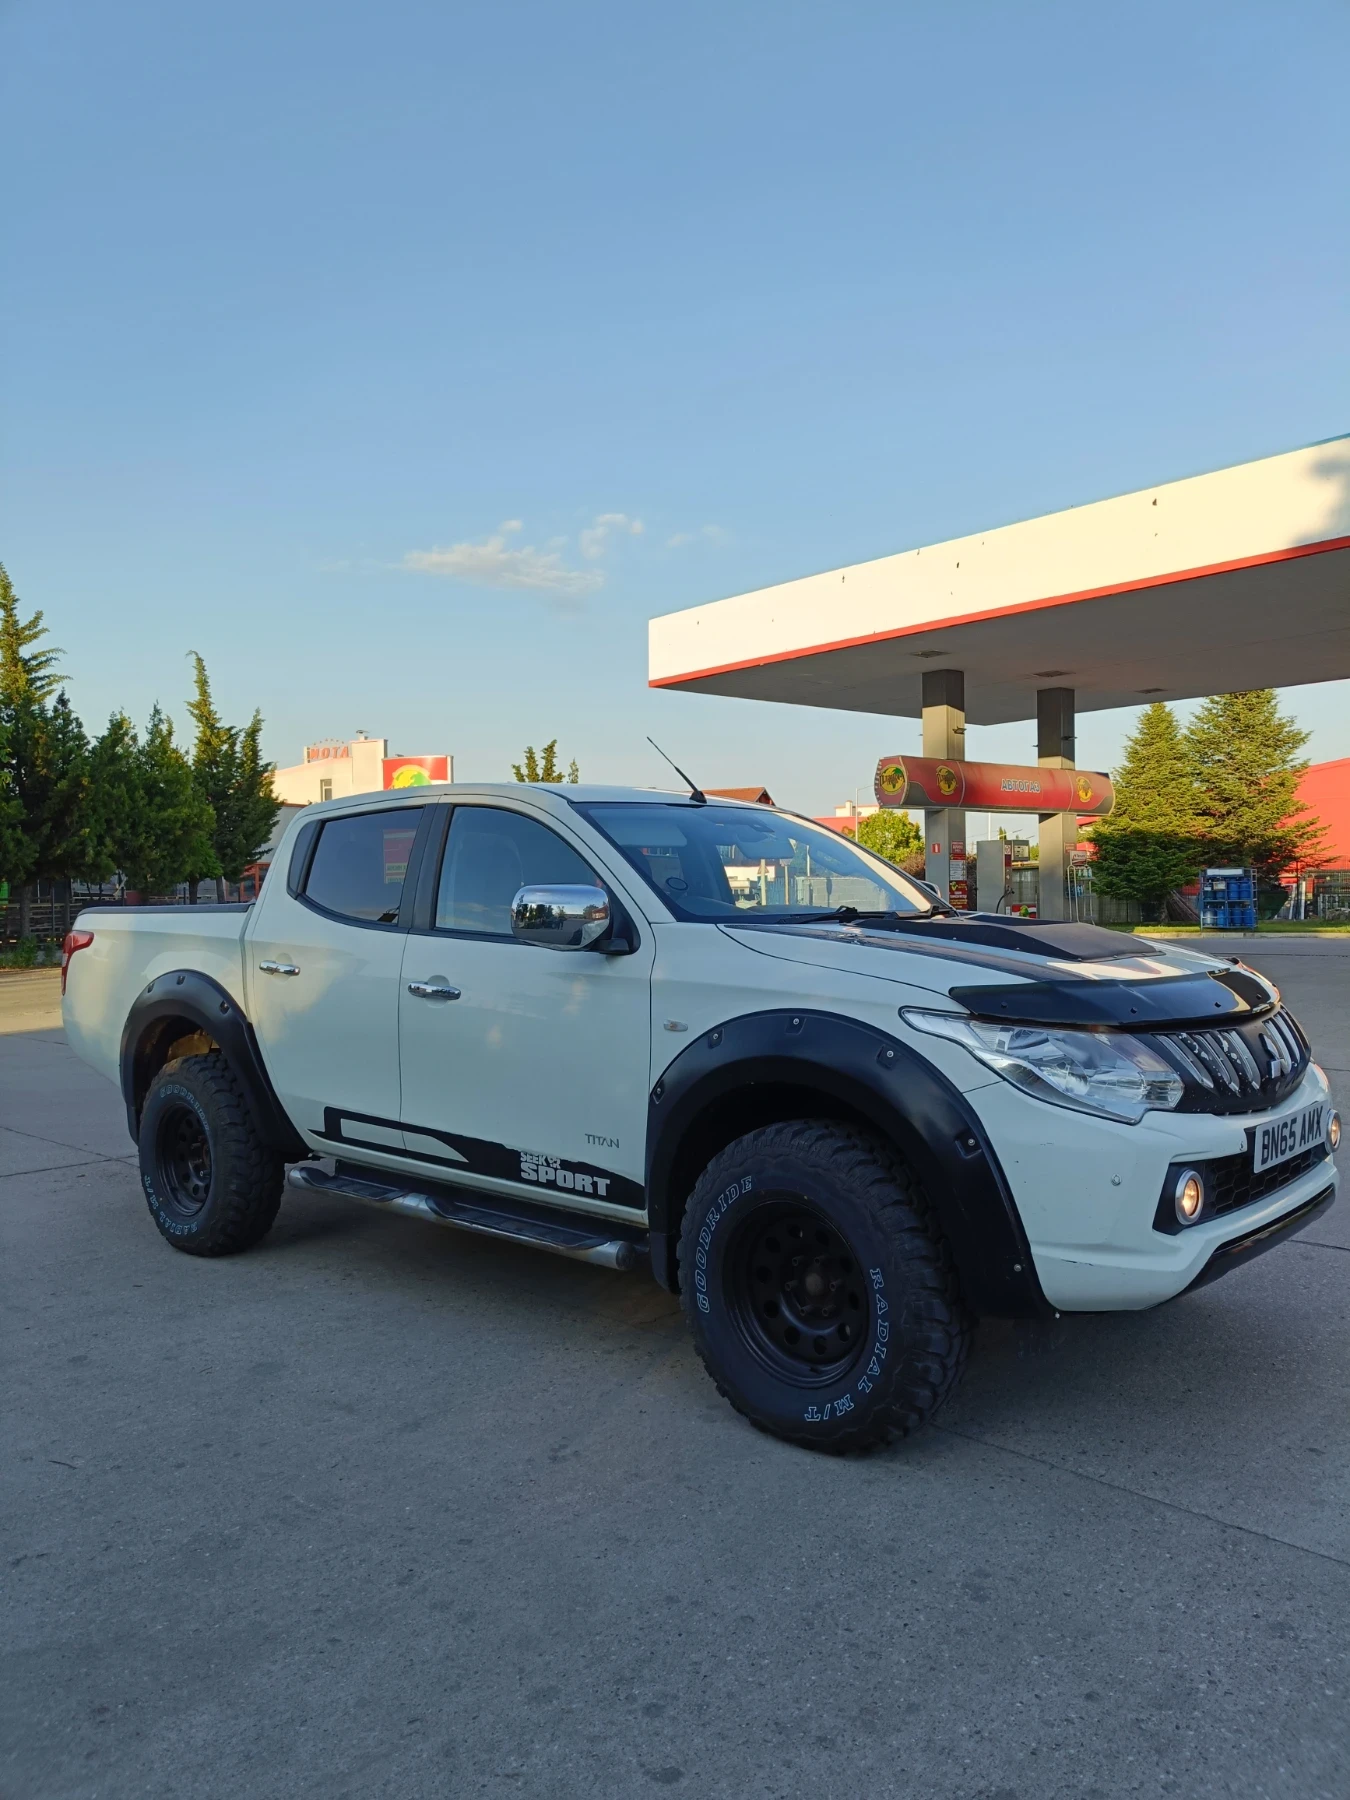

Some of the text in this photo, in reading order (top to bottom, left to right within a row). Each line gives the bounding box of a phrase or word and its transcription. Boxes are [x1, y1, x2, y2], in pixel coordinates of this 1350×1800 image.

[1001, 779, 1040, 793] АВТОГАЗ
[585, 1133, 620, 1149] TITAN
[1261, 1105, 1324, 1166] BN65 AMX
[520, 1162, 611, 1196] SPORT
[695, 1176, 752, 1313] GOODRIDE
[858, 1268, 890, 1393] RADIAL
